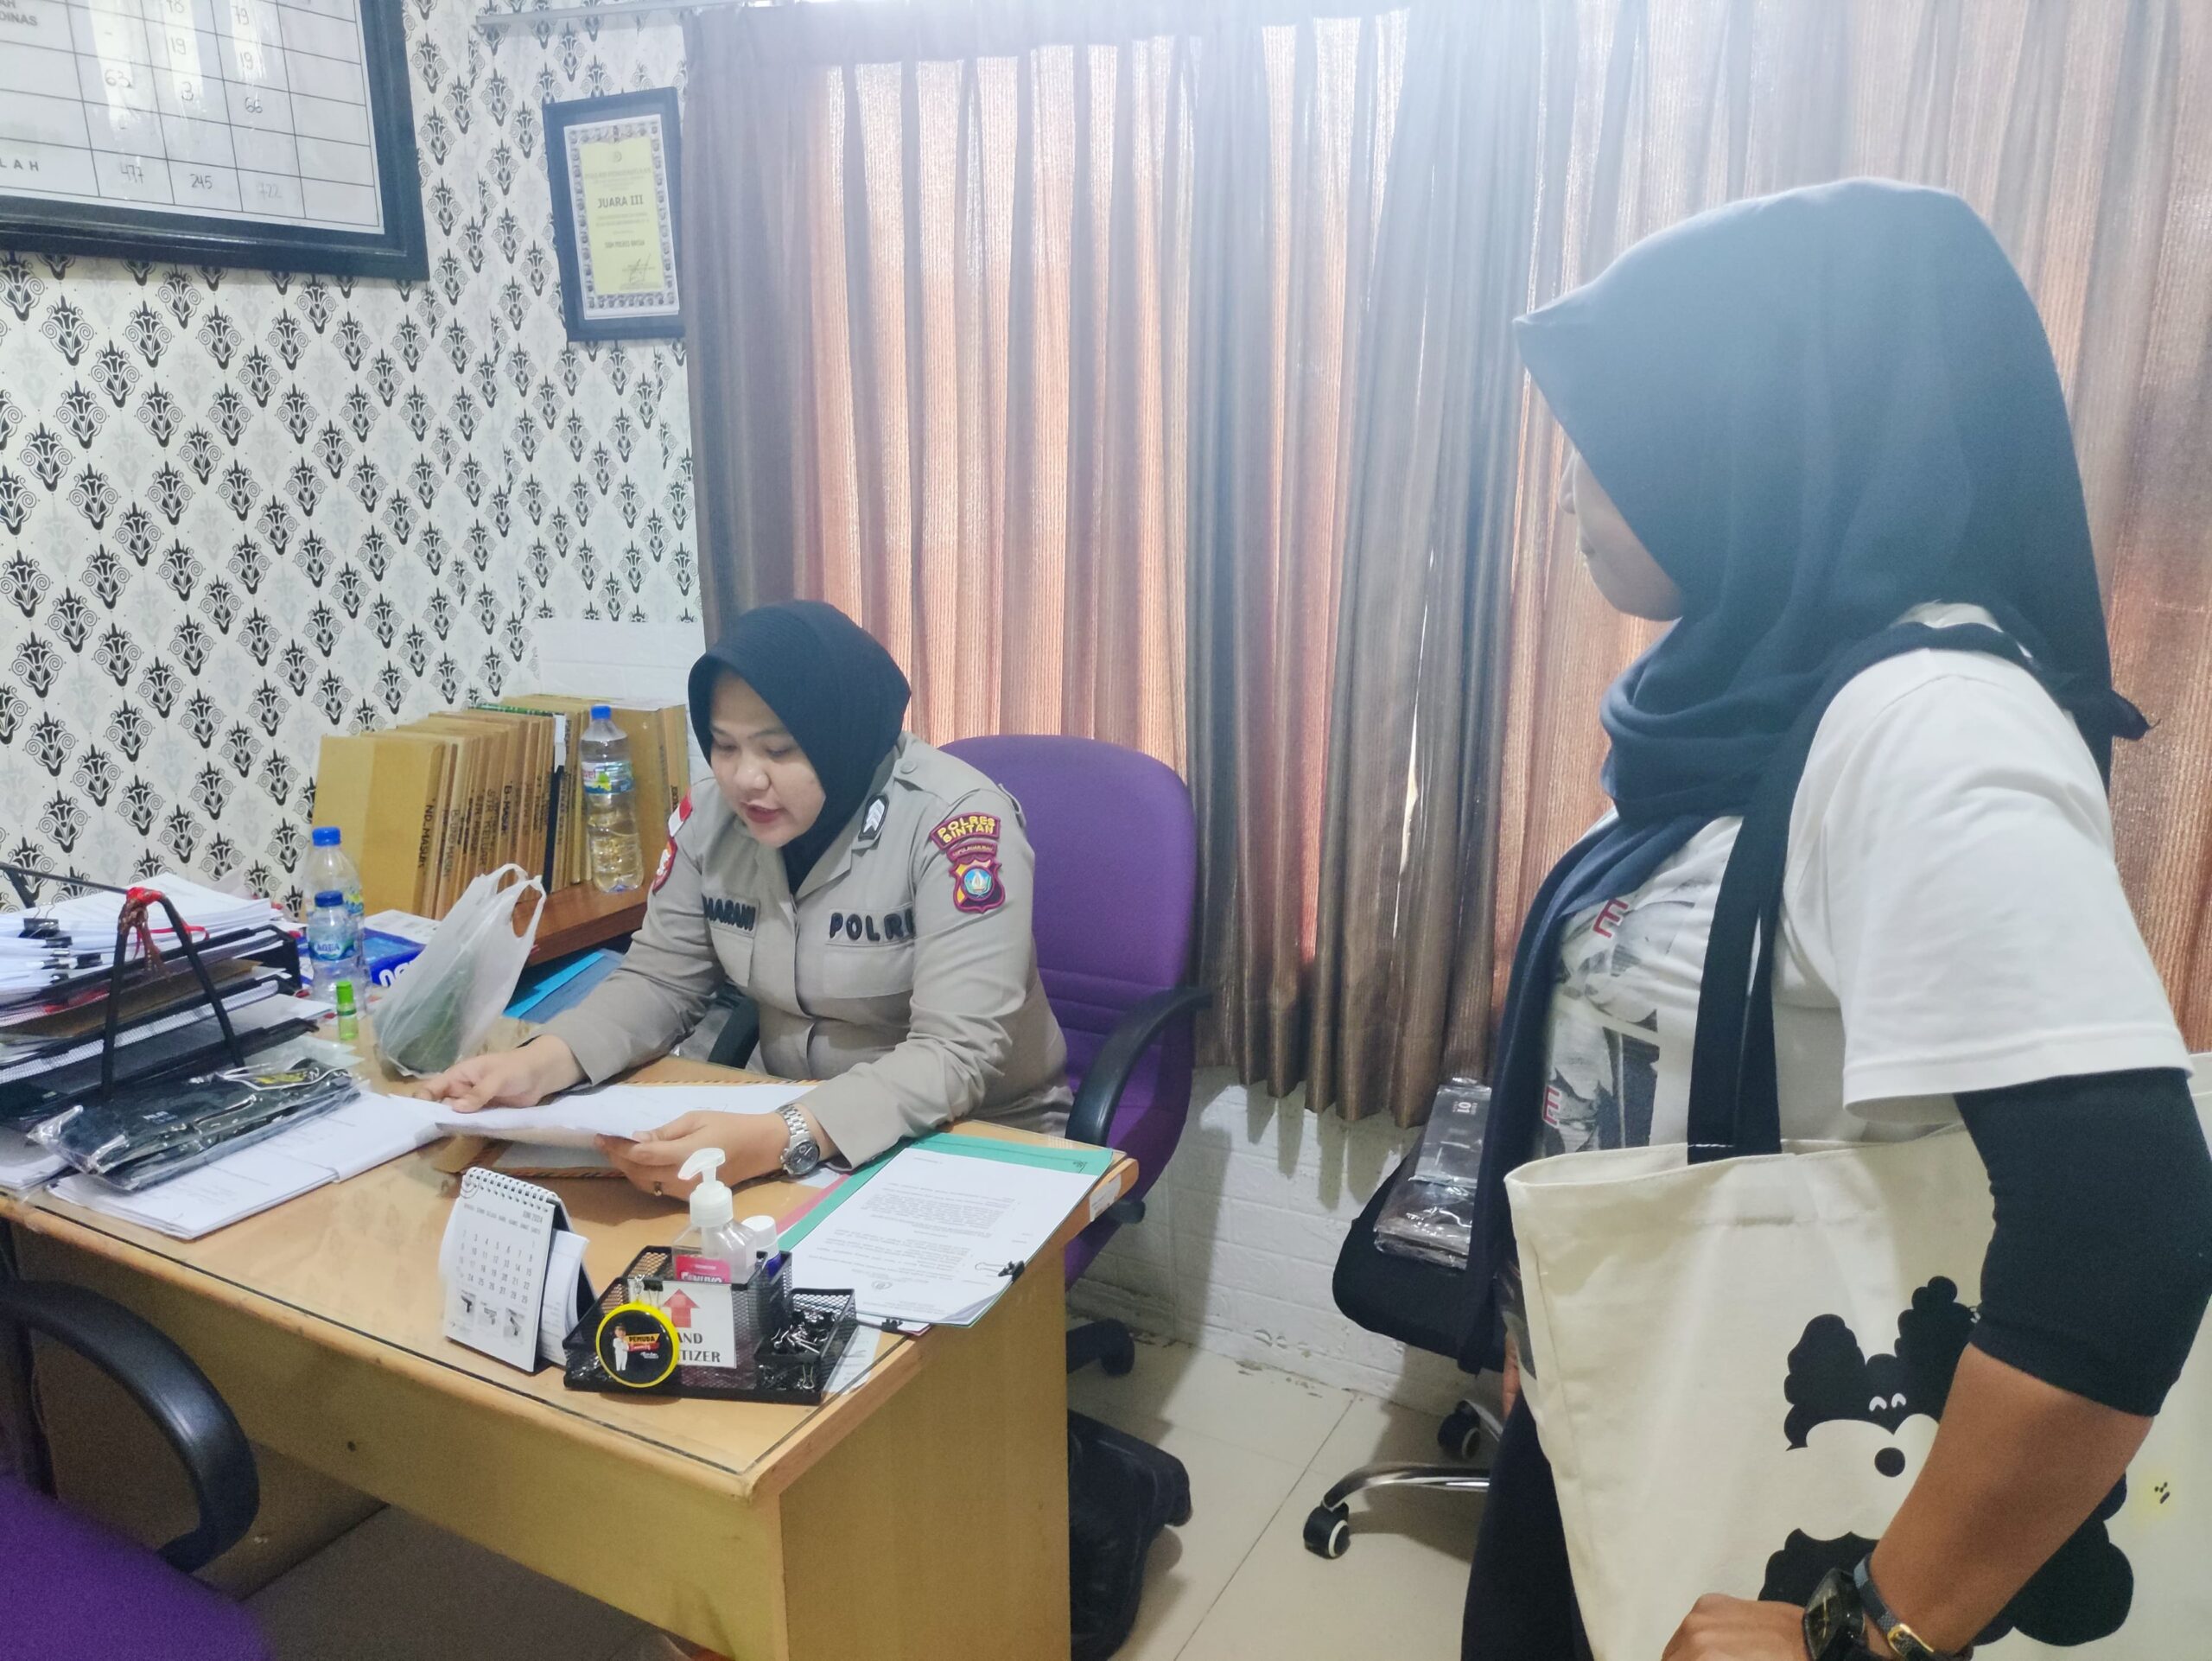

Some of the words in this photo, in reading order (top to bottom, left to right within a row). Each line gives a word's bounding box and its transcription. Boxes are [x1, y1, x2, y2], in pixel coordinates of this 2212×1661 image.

[189, 173, 213, 190] 245
[597, 195, 628, 209] JUARA
[630, 194, 645, 206] III
[938, 816, 995, 838] POLRES
[943, 824, 995, 843] BINTAN
[830, 908, 914, 942] POLRI
[679, 1349, 721, 1363] TIZER
